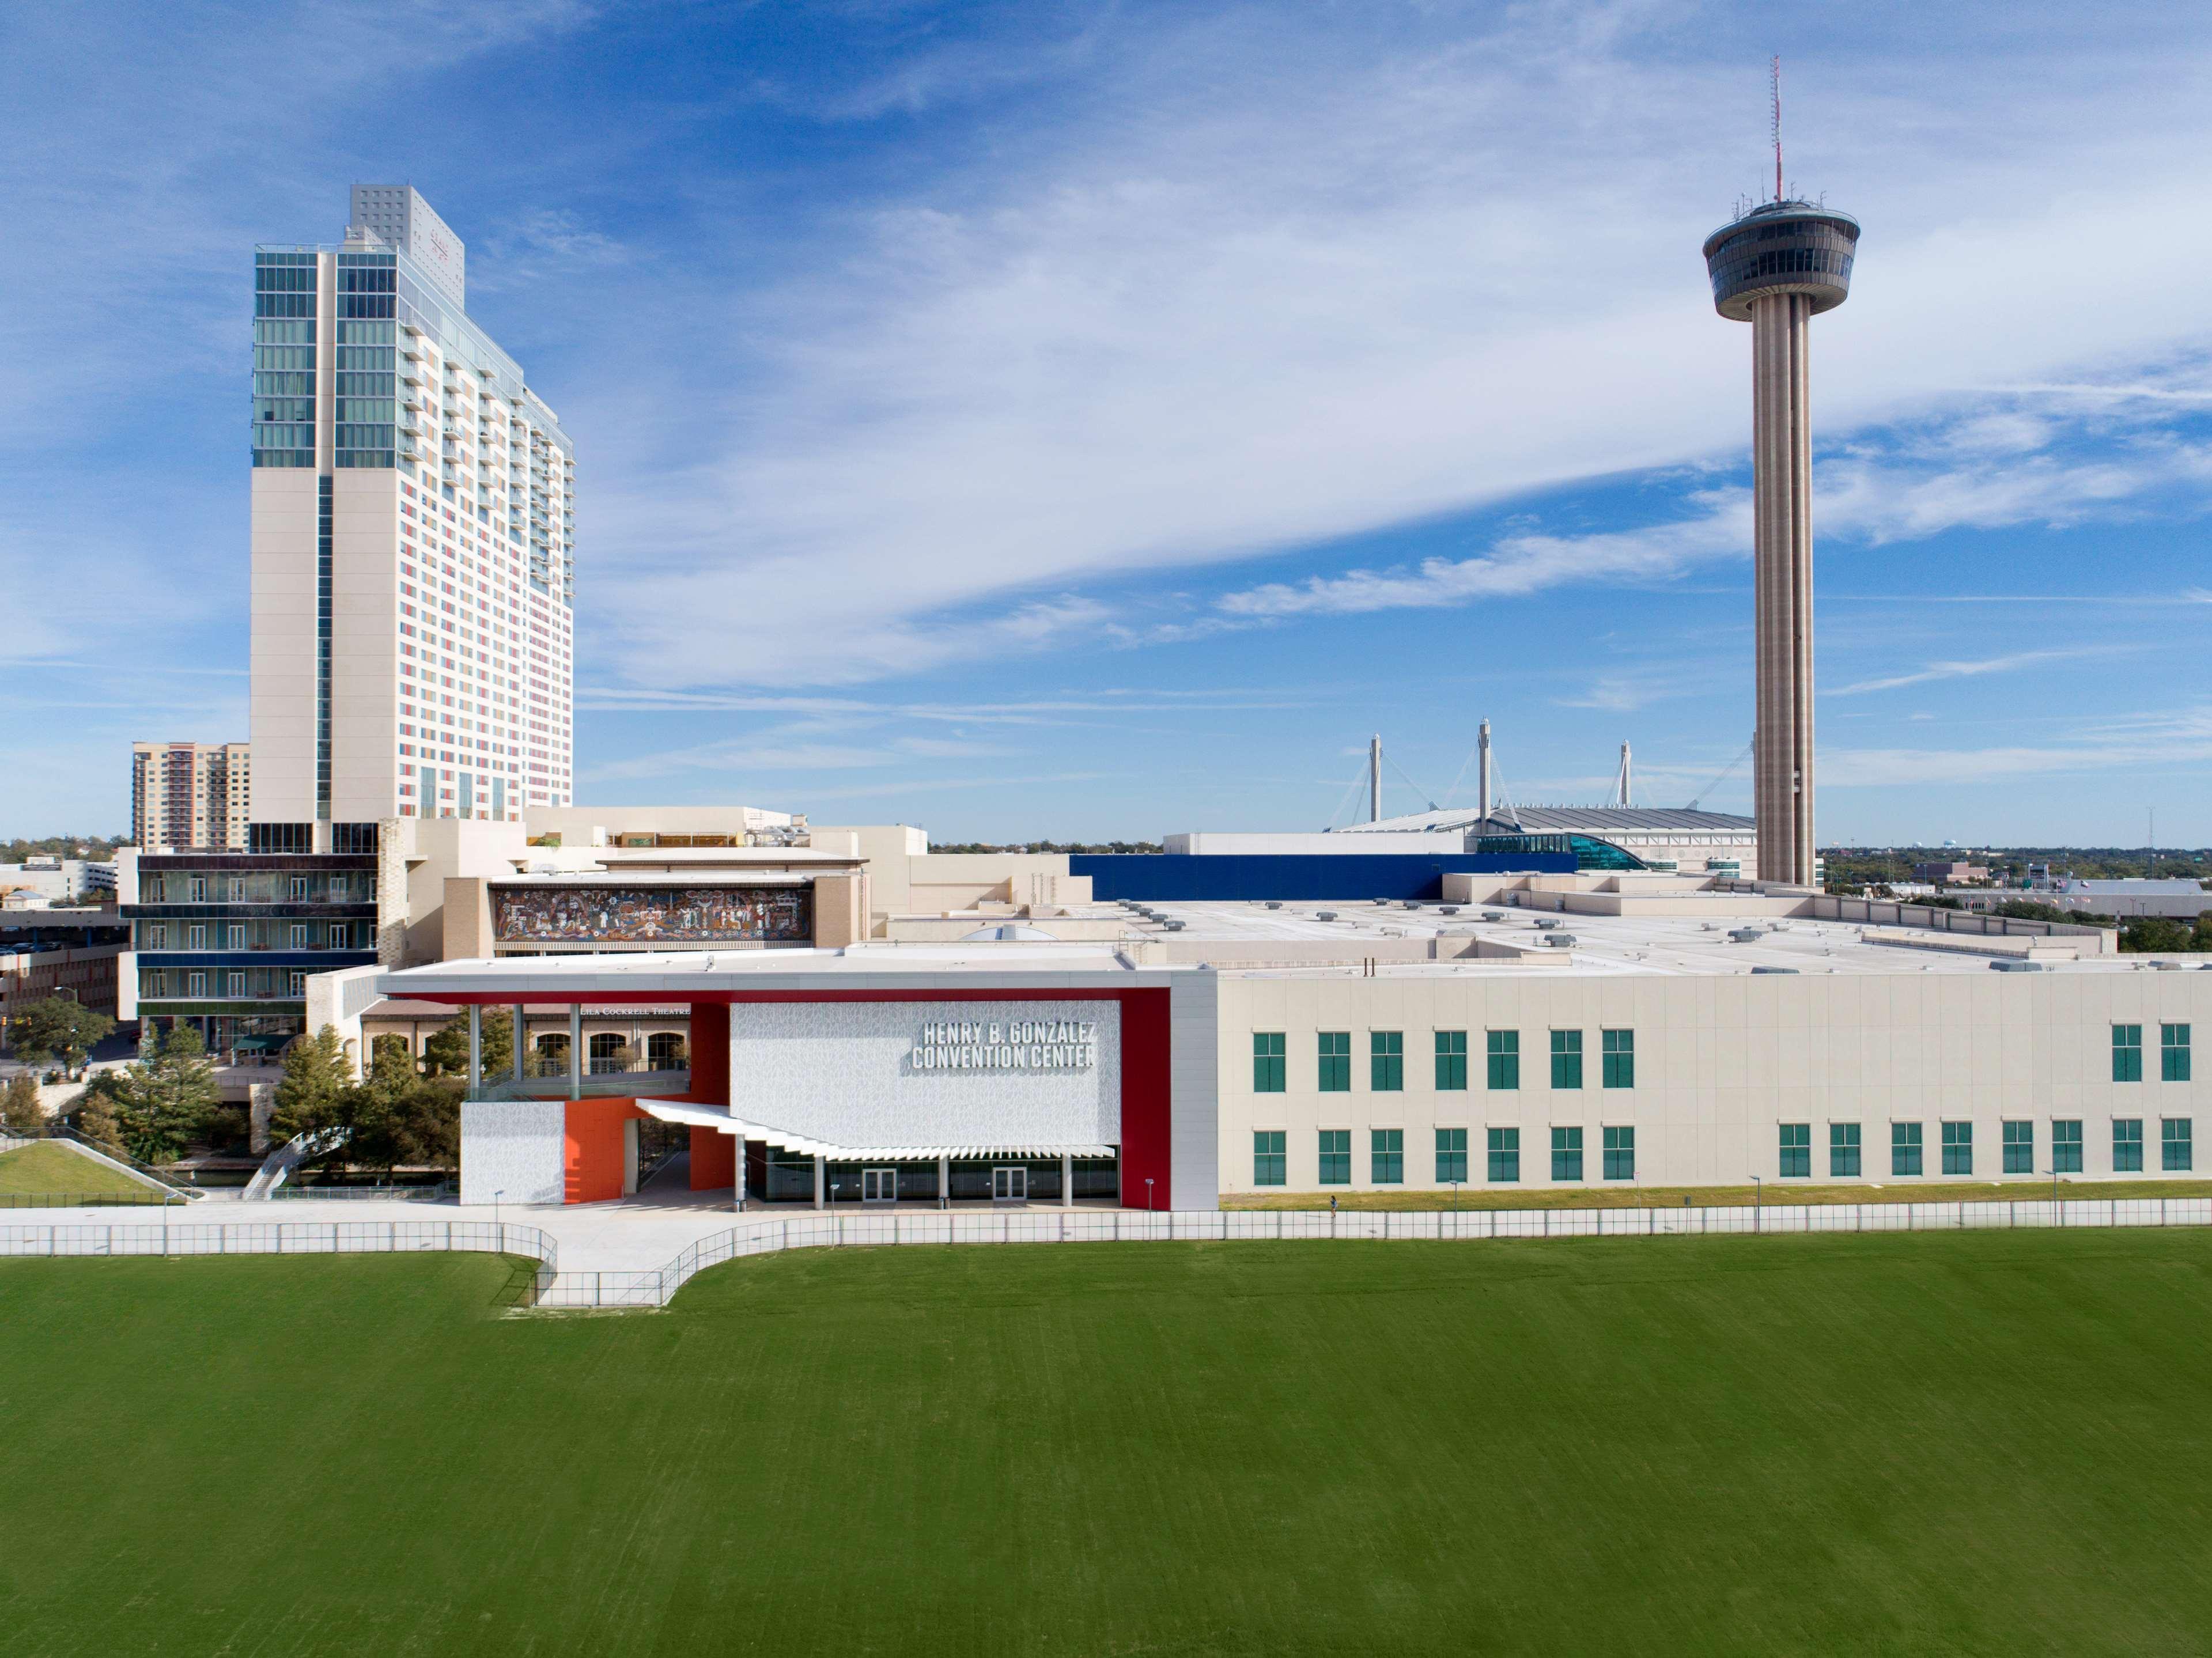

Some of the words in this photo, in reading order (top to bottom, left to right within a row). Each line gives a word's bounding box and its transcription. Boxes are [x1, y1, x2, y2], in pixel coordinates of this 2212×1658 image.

[924, 1022, 981, 1044] HENRY
[989, 1021, 1005, 1044] B.
[913, 1046, 1025, 1068] CONVENTION
[1031, 1045, 1096, 1068] CENTER
